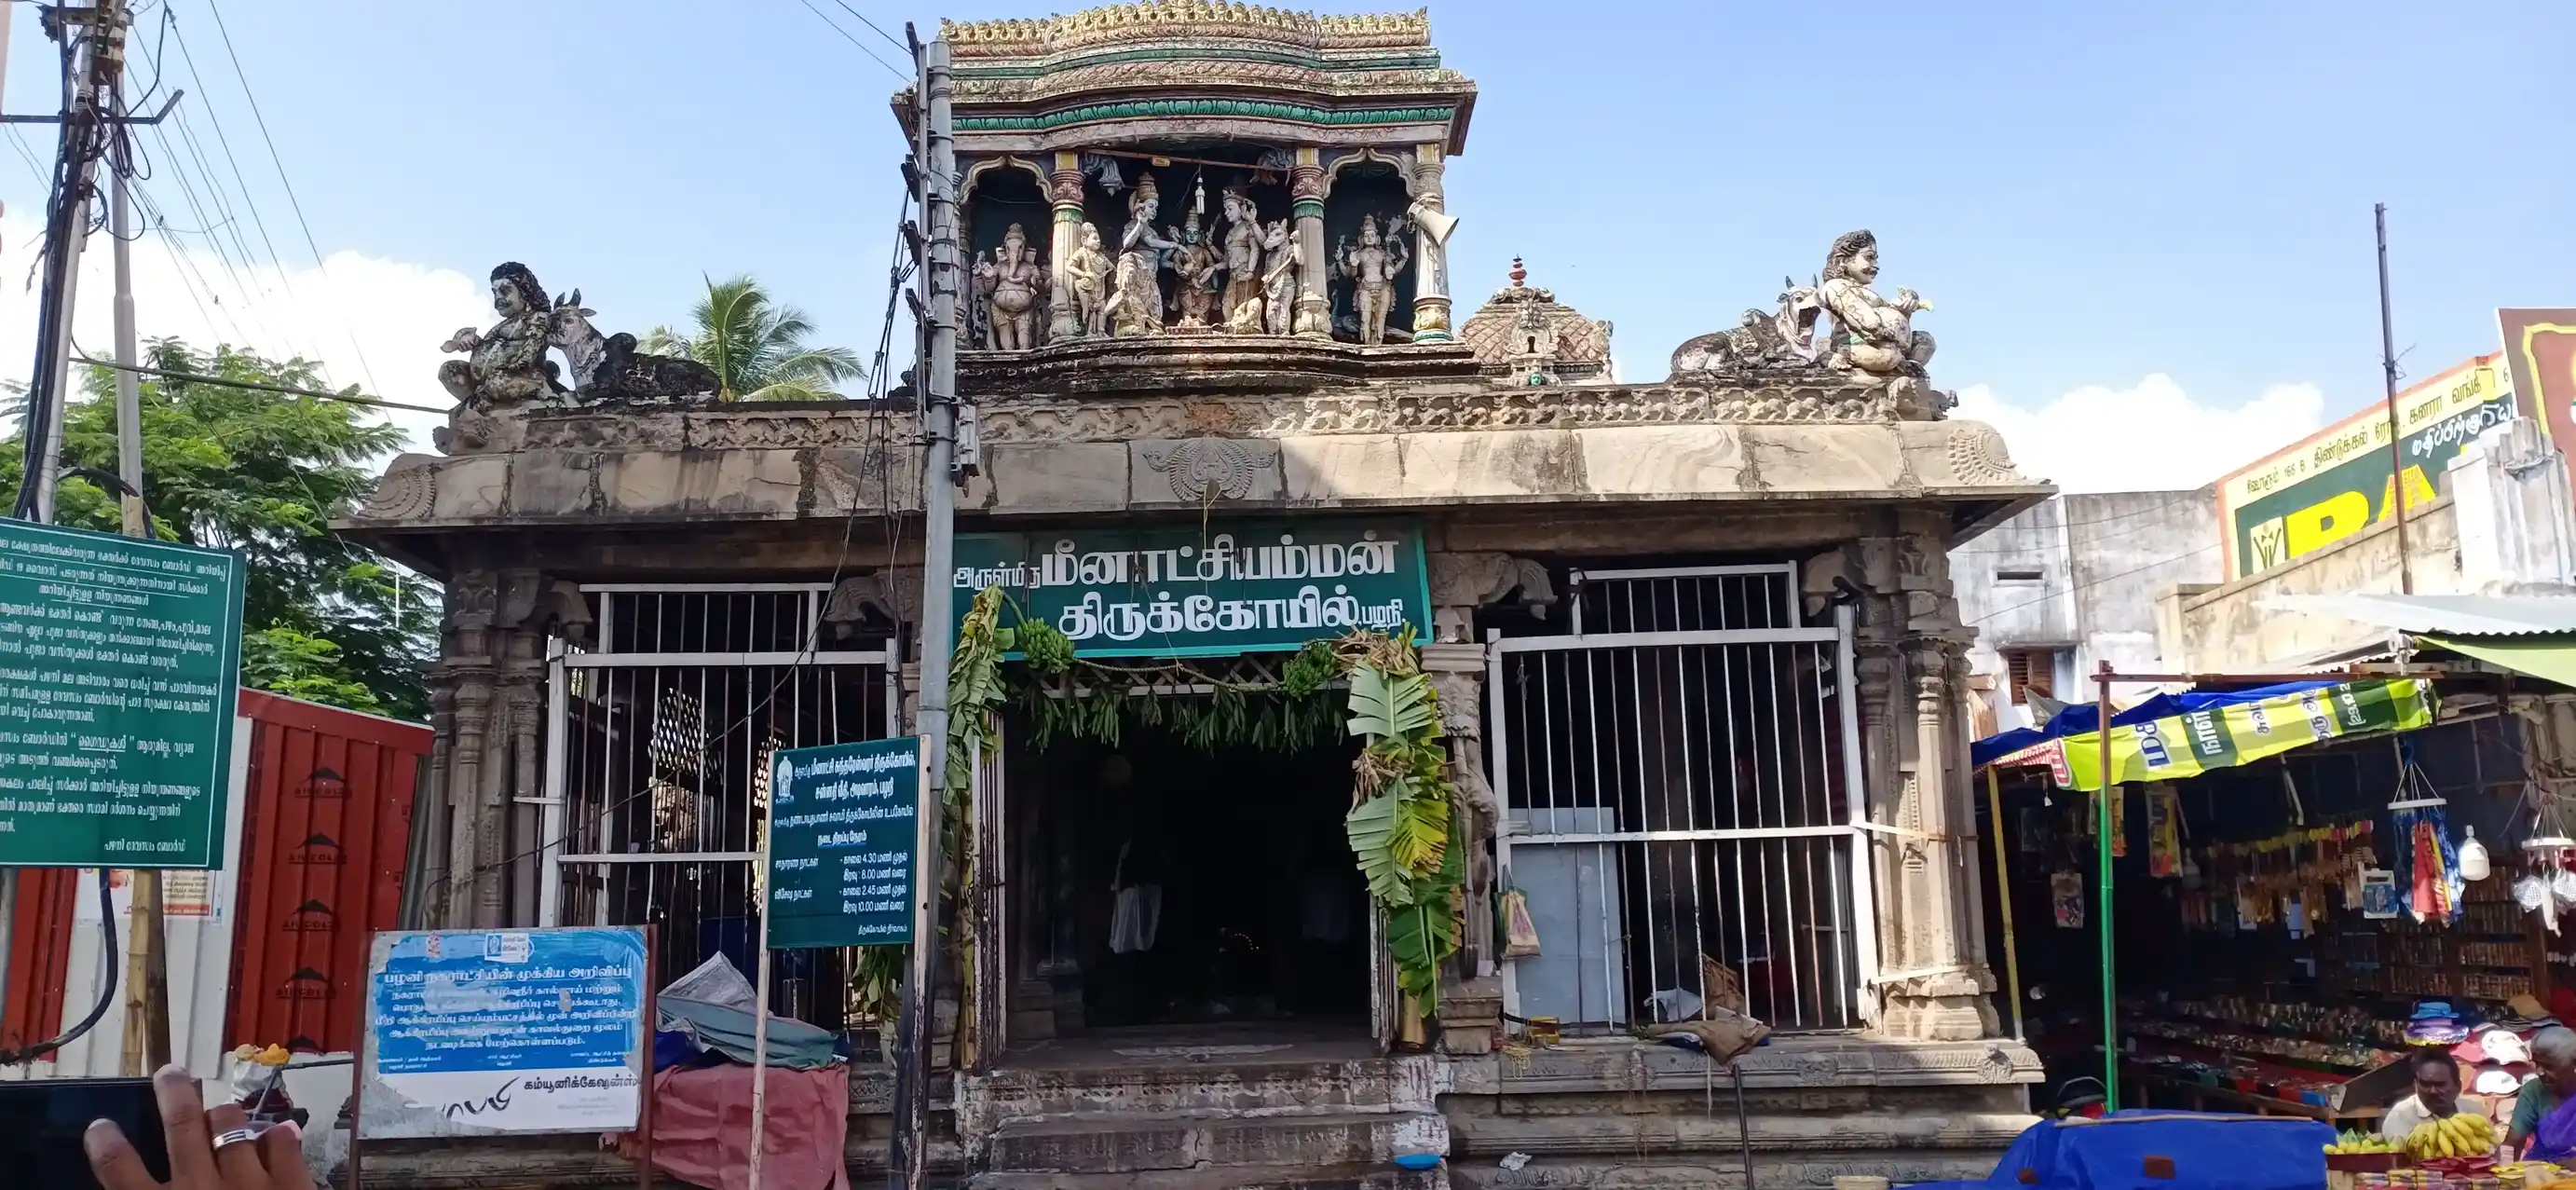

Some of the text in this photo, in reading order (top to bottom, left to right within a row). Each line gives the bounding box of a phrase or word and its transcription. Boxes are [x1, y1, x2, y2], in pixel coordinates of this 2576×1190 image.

[1042, 529, 1398, 586] மீனாட்சியம்மன்
[2186, 711, 2223, 756] நாள்
[844, 855, 862, 865] காலை
[863, 853, 877, 863] 4.30
[878, 852, 892, 863] மணி
[862, 869, 876, 879] 8.00
[877, 867, 892, 879] மணி
[843, 887, 862, 896] காலை
[862, 884, 877, 896] 2.45
[877, 883, 892, 895] மணி
[858, 900, 874, 911] 10.00
[875, 899, 890, 910] மணி
[516, 966, 565, 981] முக்கிய
[568, 964, 632, 978] அறிவிப்பு
